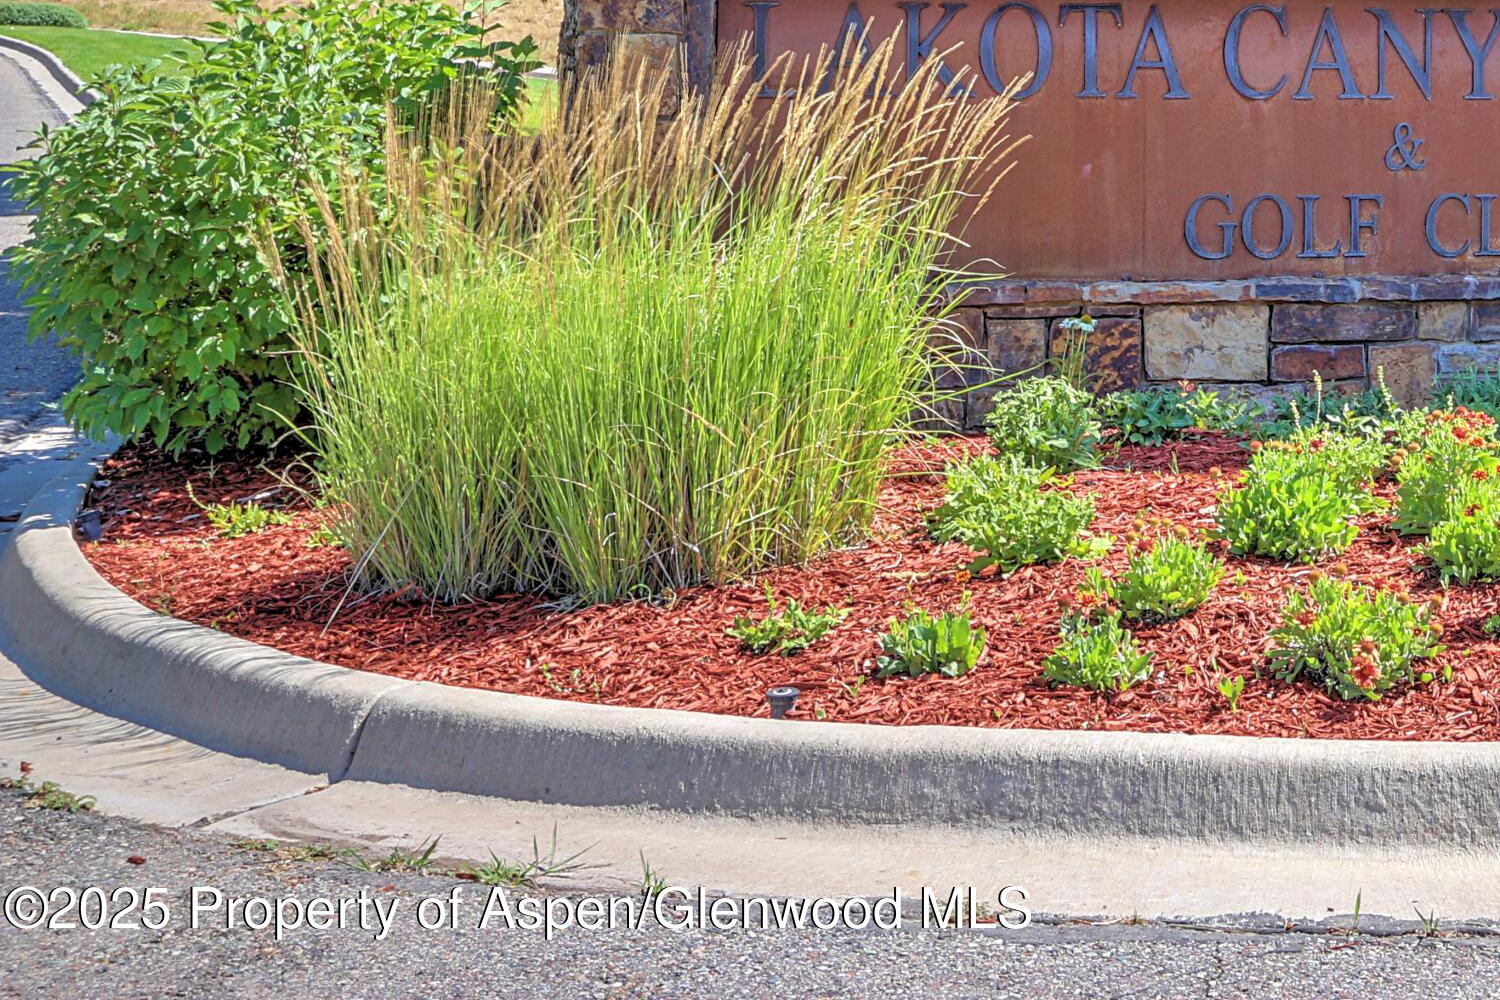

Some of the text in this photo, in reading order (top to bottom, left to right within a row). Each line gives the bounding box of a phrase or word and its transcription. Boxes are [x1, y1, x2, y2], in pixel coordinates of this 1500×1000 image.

[745, 1, 1191, 99] LAKOTA
[1384, 122, 1426, 172] &
[1184, 194, 1384, 260] GOLF
